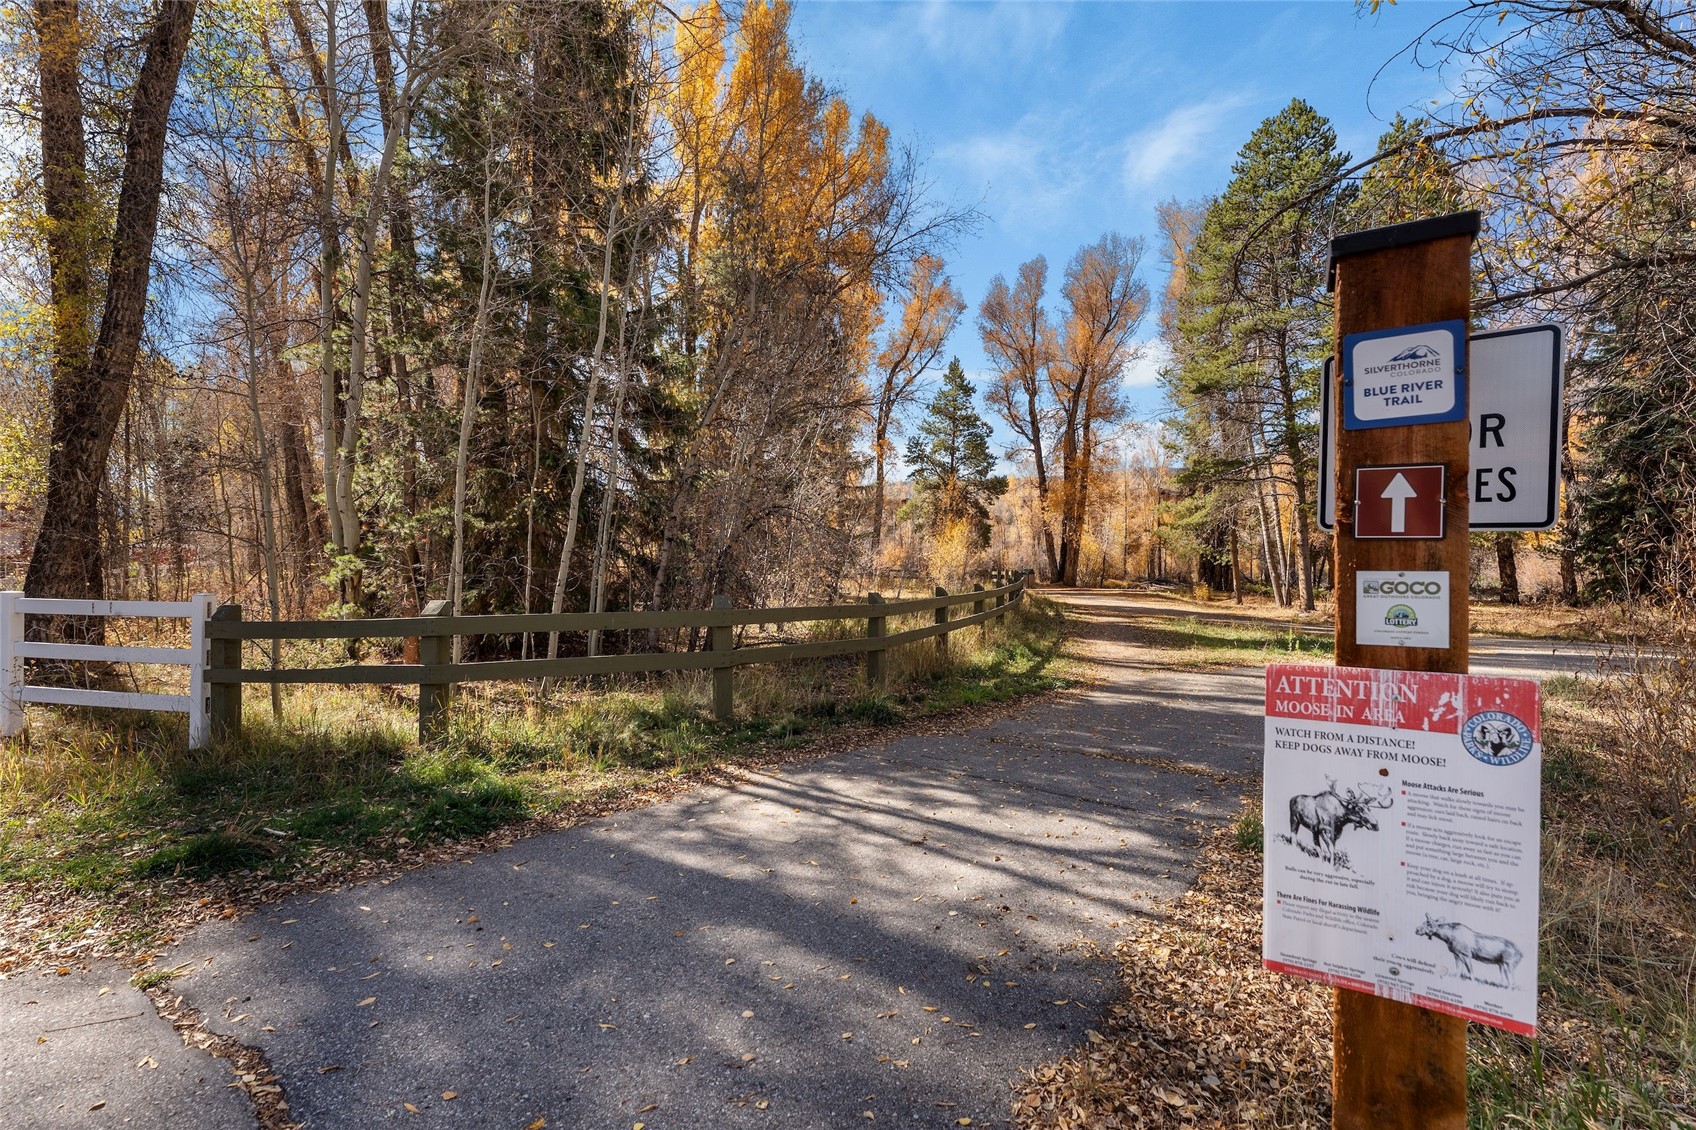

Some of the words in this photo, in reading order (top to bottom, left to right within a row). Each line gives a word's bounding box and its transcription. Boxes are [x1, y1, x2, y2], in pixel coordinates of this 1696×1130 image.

[1364, 358, 1441, 375] SILVERTHORNE
[1390, 366, 1441, 378] COLORADO
[1363, 385, 1397, 398] BLUE
[1401, 379, 1443, 393] RIVER
[1383, 394, 1423, 407] TRAIL
[1469, 413, 1506, 449] R
[1379, 581, 1442, 595] GOCO
[1386, 617, 1417, 626] LOTTERY
[1275, 675, 1418, 704] ATTENTION
[1441, 675, 1519, 687] WIDLIFE
[1275, 700, 1331, 716] MOOSE
[1335, 705, 1354, 718] IN
[1361, 710, 1406, 724] AREA
[1467, 712, 1527, 733] COLORADO
[1275, 727, 1311, 739] WATCH
[1314, 731, 1344, 743] FROM
[1347, 734, 1355, 744] A
[1357, 735, 1415, 750] DISTANCE!
[1275, 740, 1300, 752] KEEP
[1302, 743, 1332, 755] DOGS
[1334, 746, 1365, 759] AWAY
[1367, 749, 1398, 763] FROM
[1401, 753, 1447, 768] MOOSE!
[1489, 737, 1531, 765] WILDLIFE
[1402, 779, 1422, 788] Moose
[1423, 782, 1446, 791] Attacks
[1460, 788, 1484, 797] Serious
[1277, 890, 1292, 899] There
[1293, 893, 1302, 901] Are
[1303, 895, 1317, 904] Fines
[1318, 898, 1327, 906] For
[1328, 900, 1356, 912] Harassing
[1357, 905, 1380, 916] Wildlife
